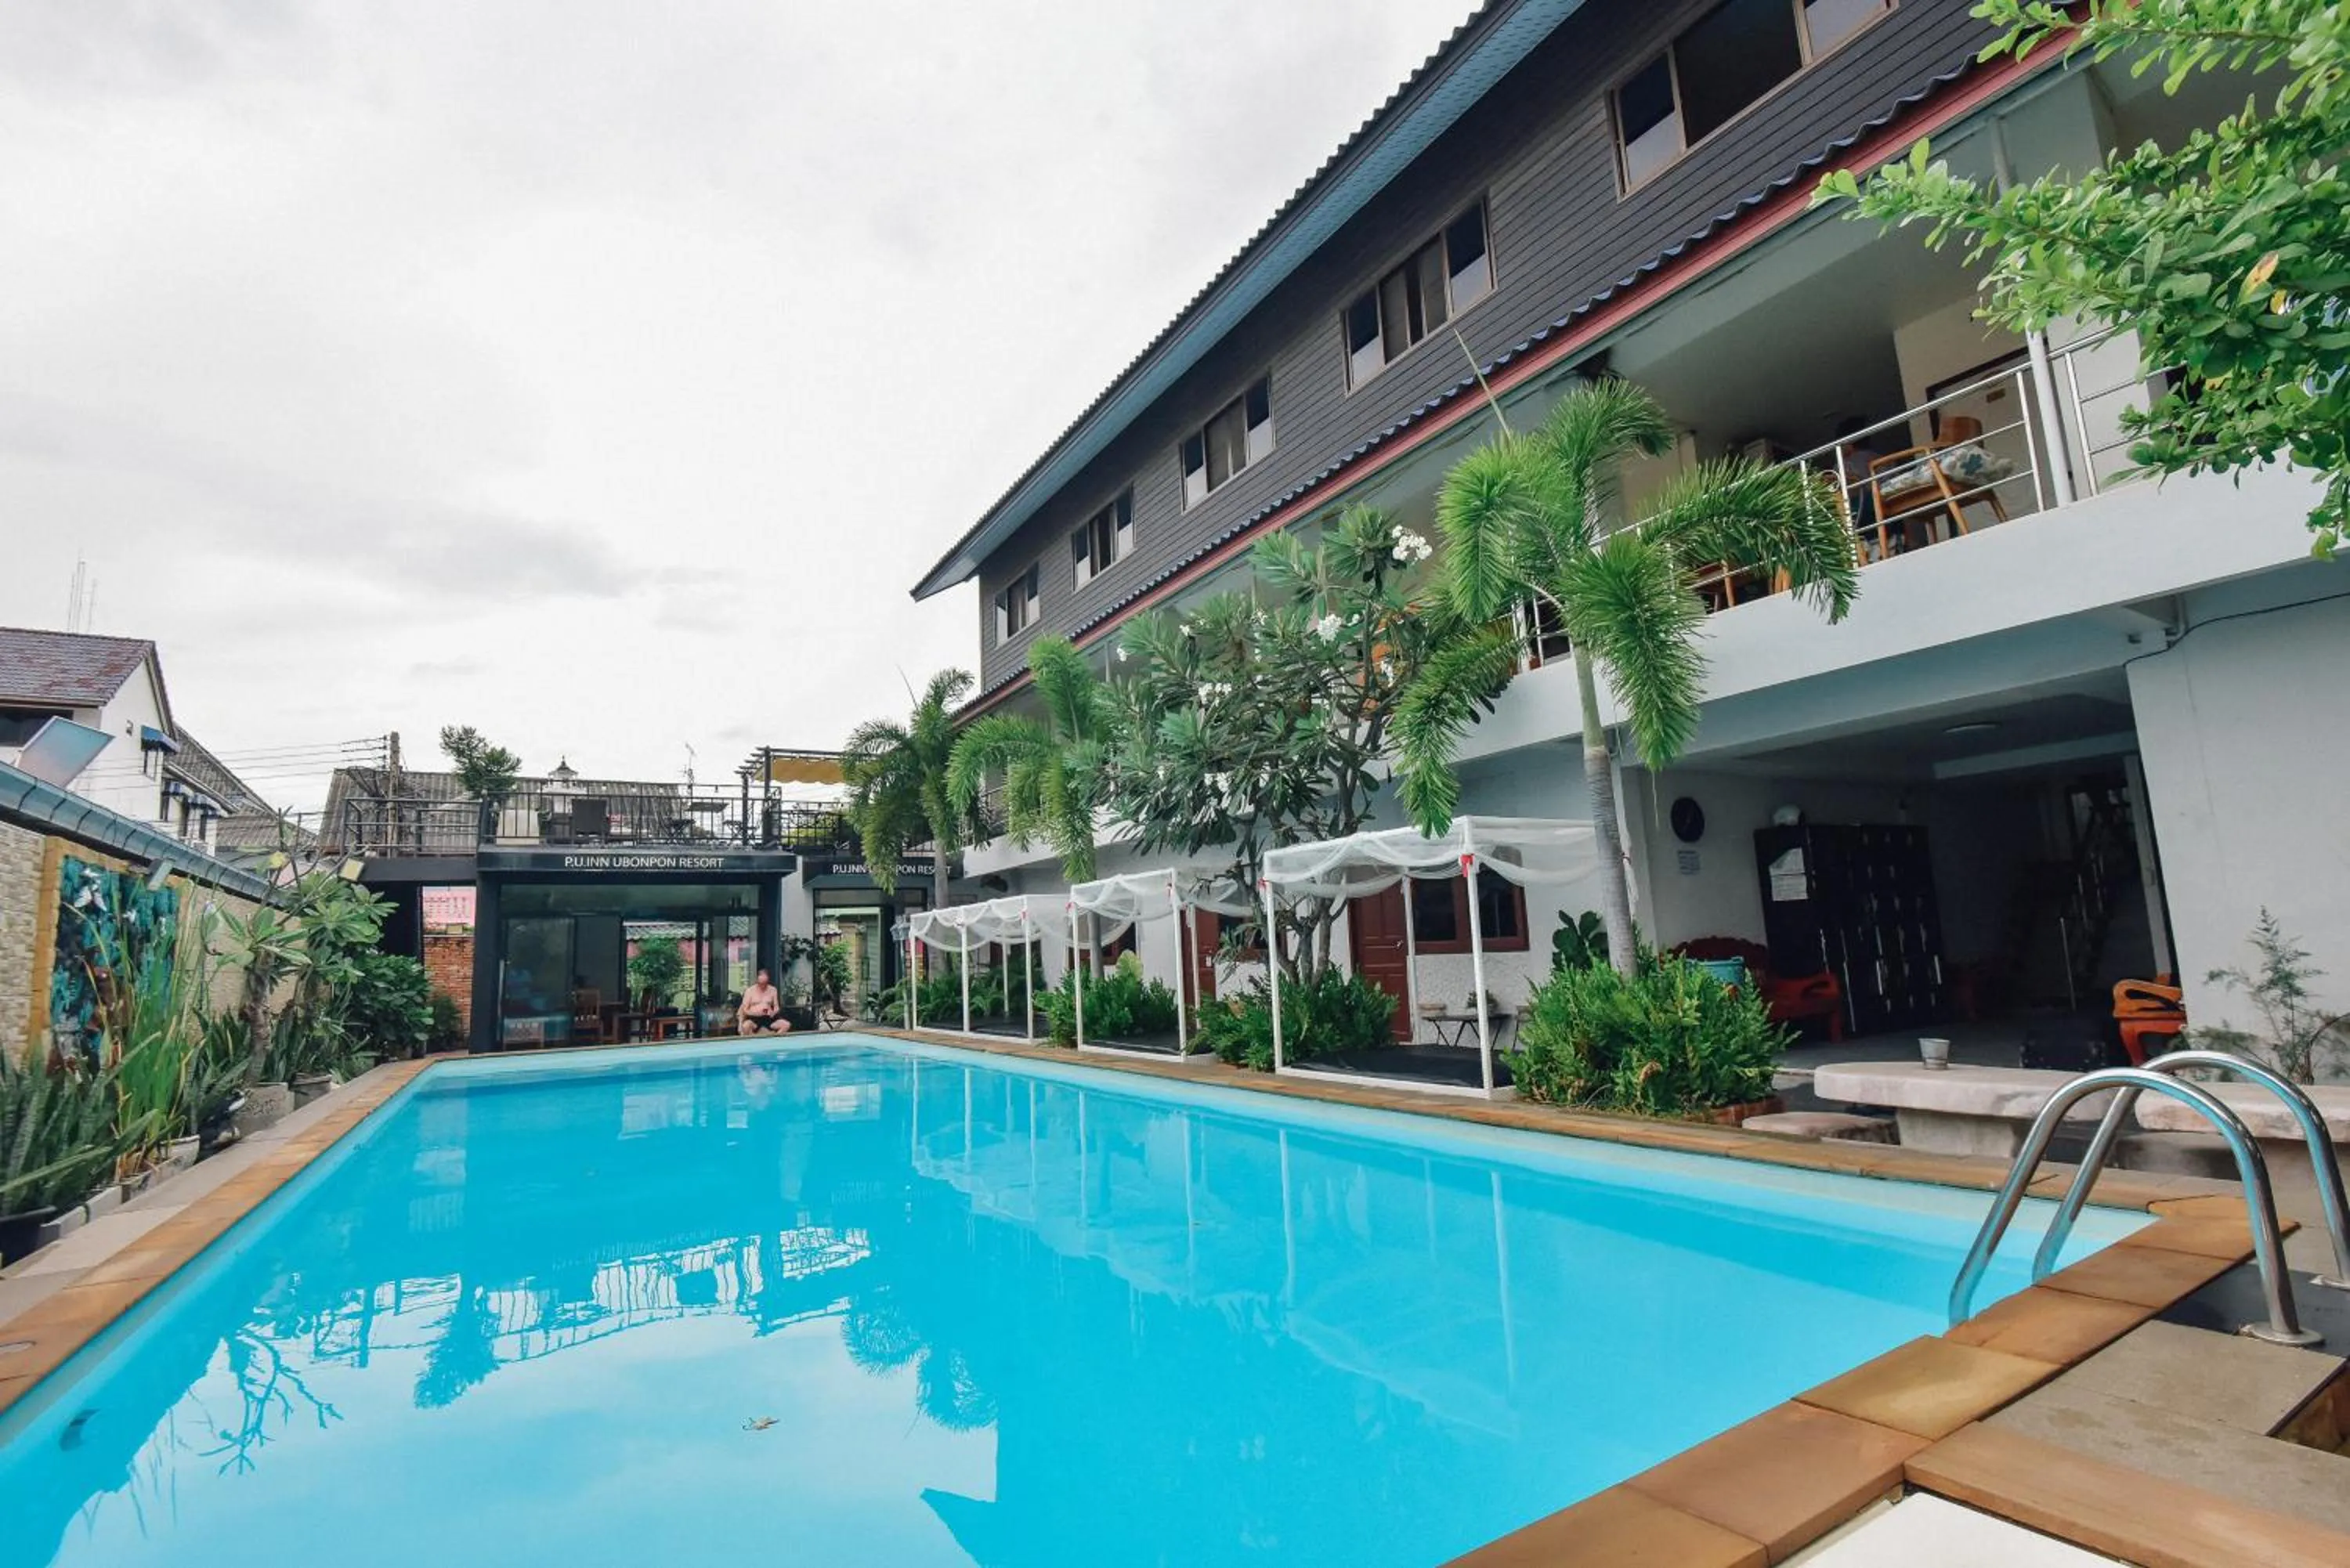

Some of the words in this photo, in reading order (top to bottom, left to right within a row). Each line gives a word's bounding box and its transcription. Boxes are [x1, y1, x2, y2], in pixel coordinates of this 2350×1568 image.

[613, 856, 676, 867] UBONPON
[679, 858, 725, 868] RESORT
[917, 865, 953, 875] REST
